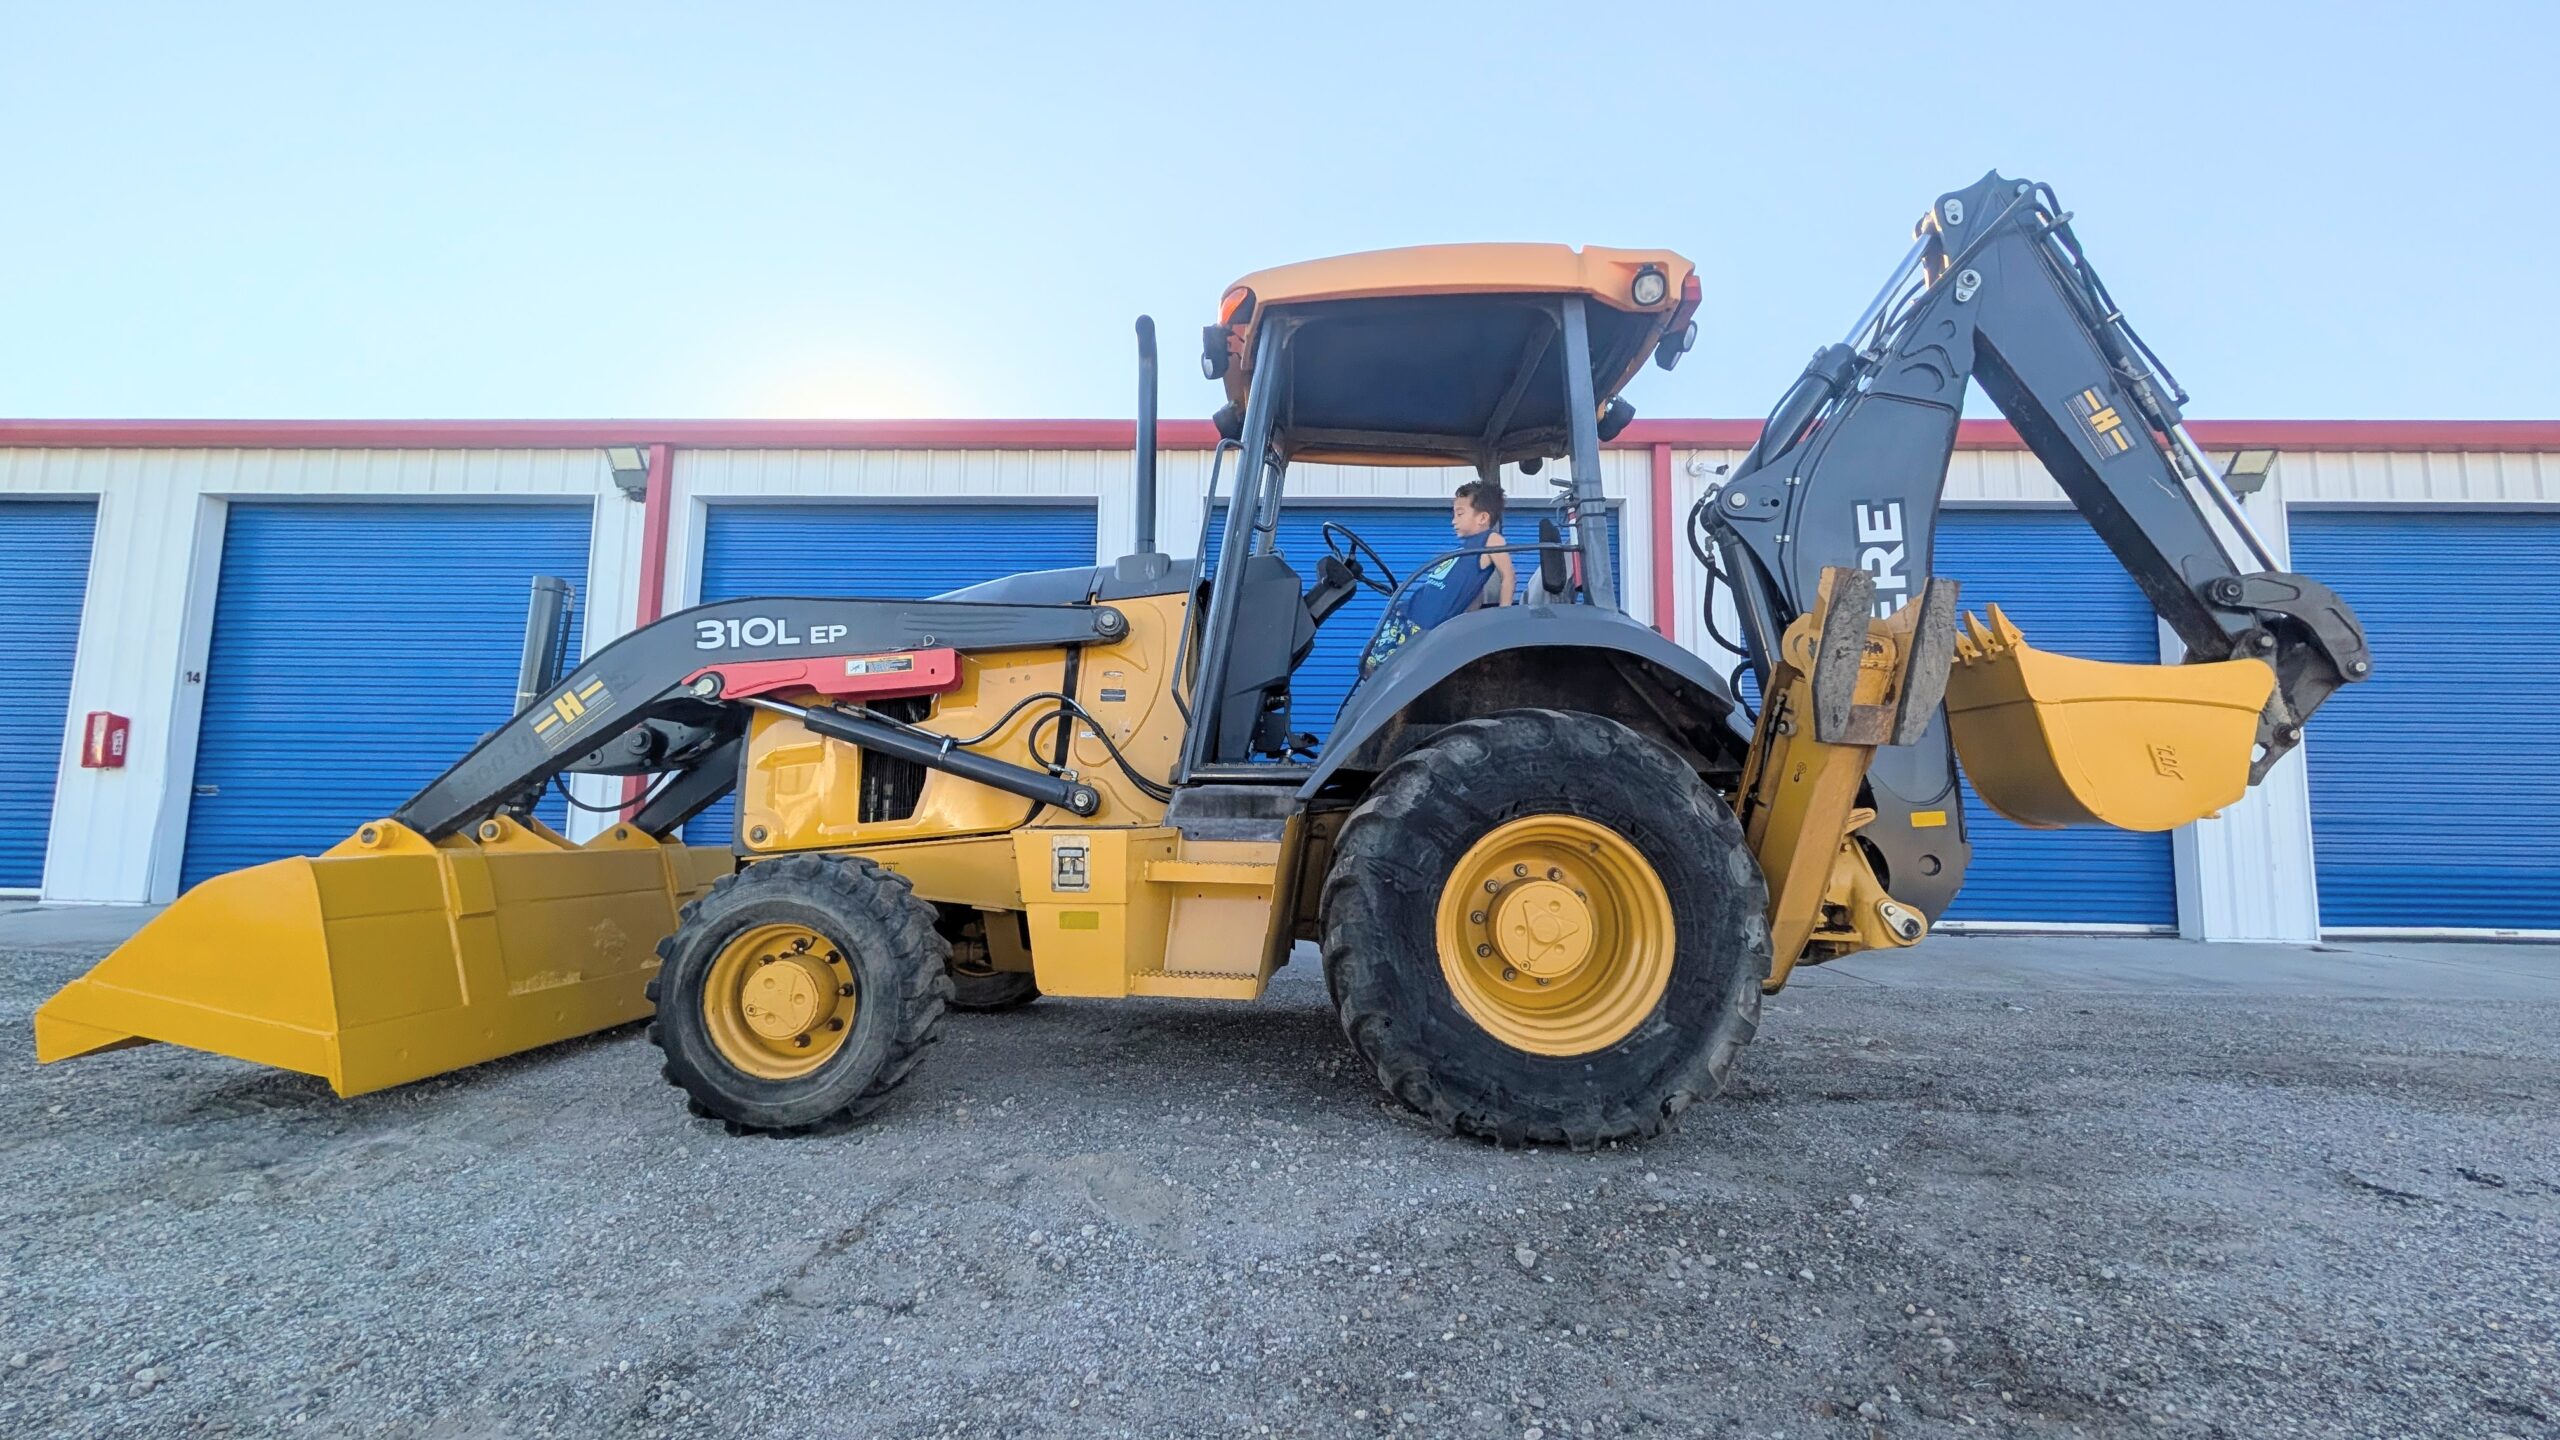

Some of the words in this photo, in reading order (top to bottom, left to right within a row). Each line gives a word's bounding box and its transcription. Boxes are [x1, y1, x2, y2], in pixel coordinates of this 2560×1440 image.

[696, 617, 800, 649] 310L
[810, 624, 848, 645] EP
[186, 671, 201, 684] 14
